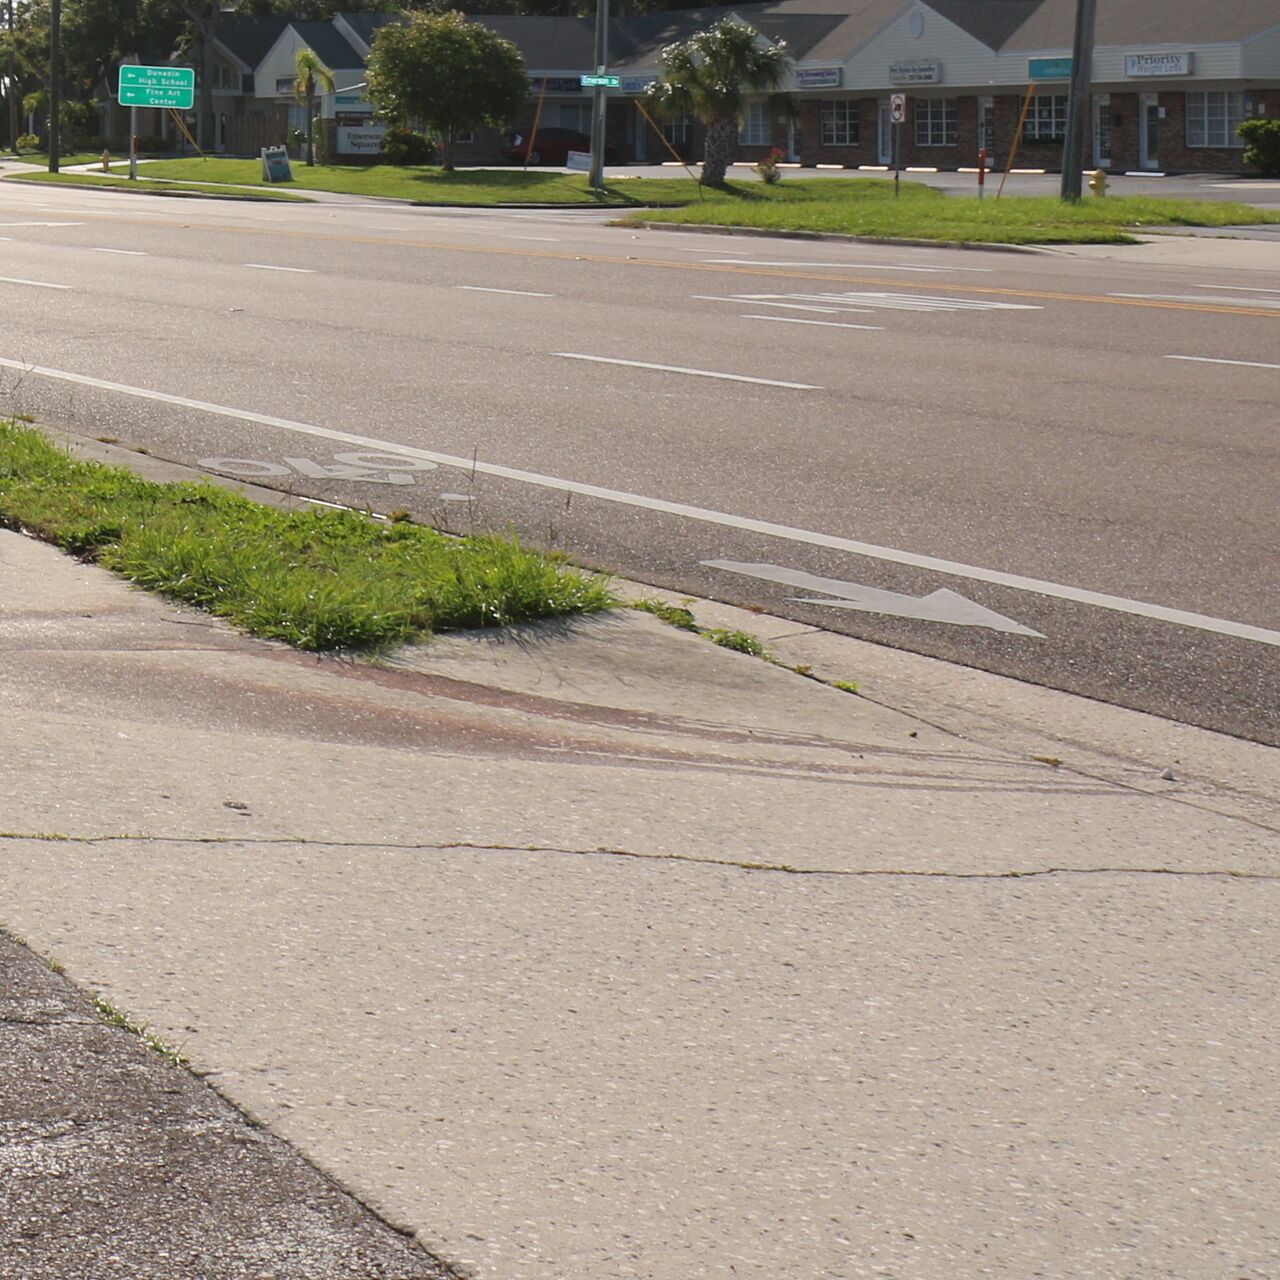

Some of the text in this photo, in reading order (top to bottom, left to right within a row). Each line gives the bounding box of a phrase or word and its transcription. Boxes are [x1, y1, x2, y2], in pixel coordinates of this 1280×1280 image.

[1137, 54, 1181, 65] Priority
[147, 69, 180, 77] Dunedin
[1137, 63, 1182, 74] Weight Loss
[139, 77, 187, 86] High School
[582, 75, 608, 85] Emerson
[146, 88, 163, 96] Fine
[149, 97, 176, 105] Center
